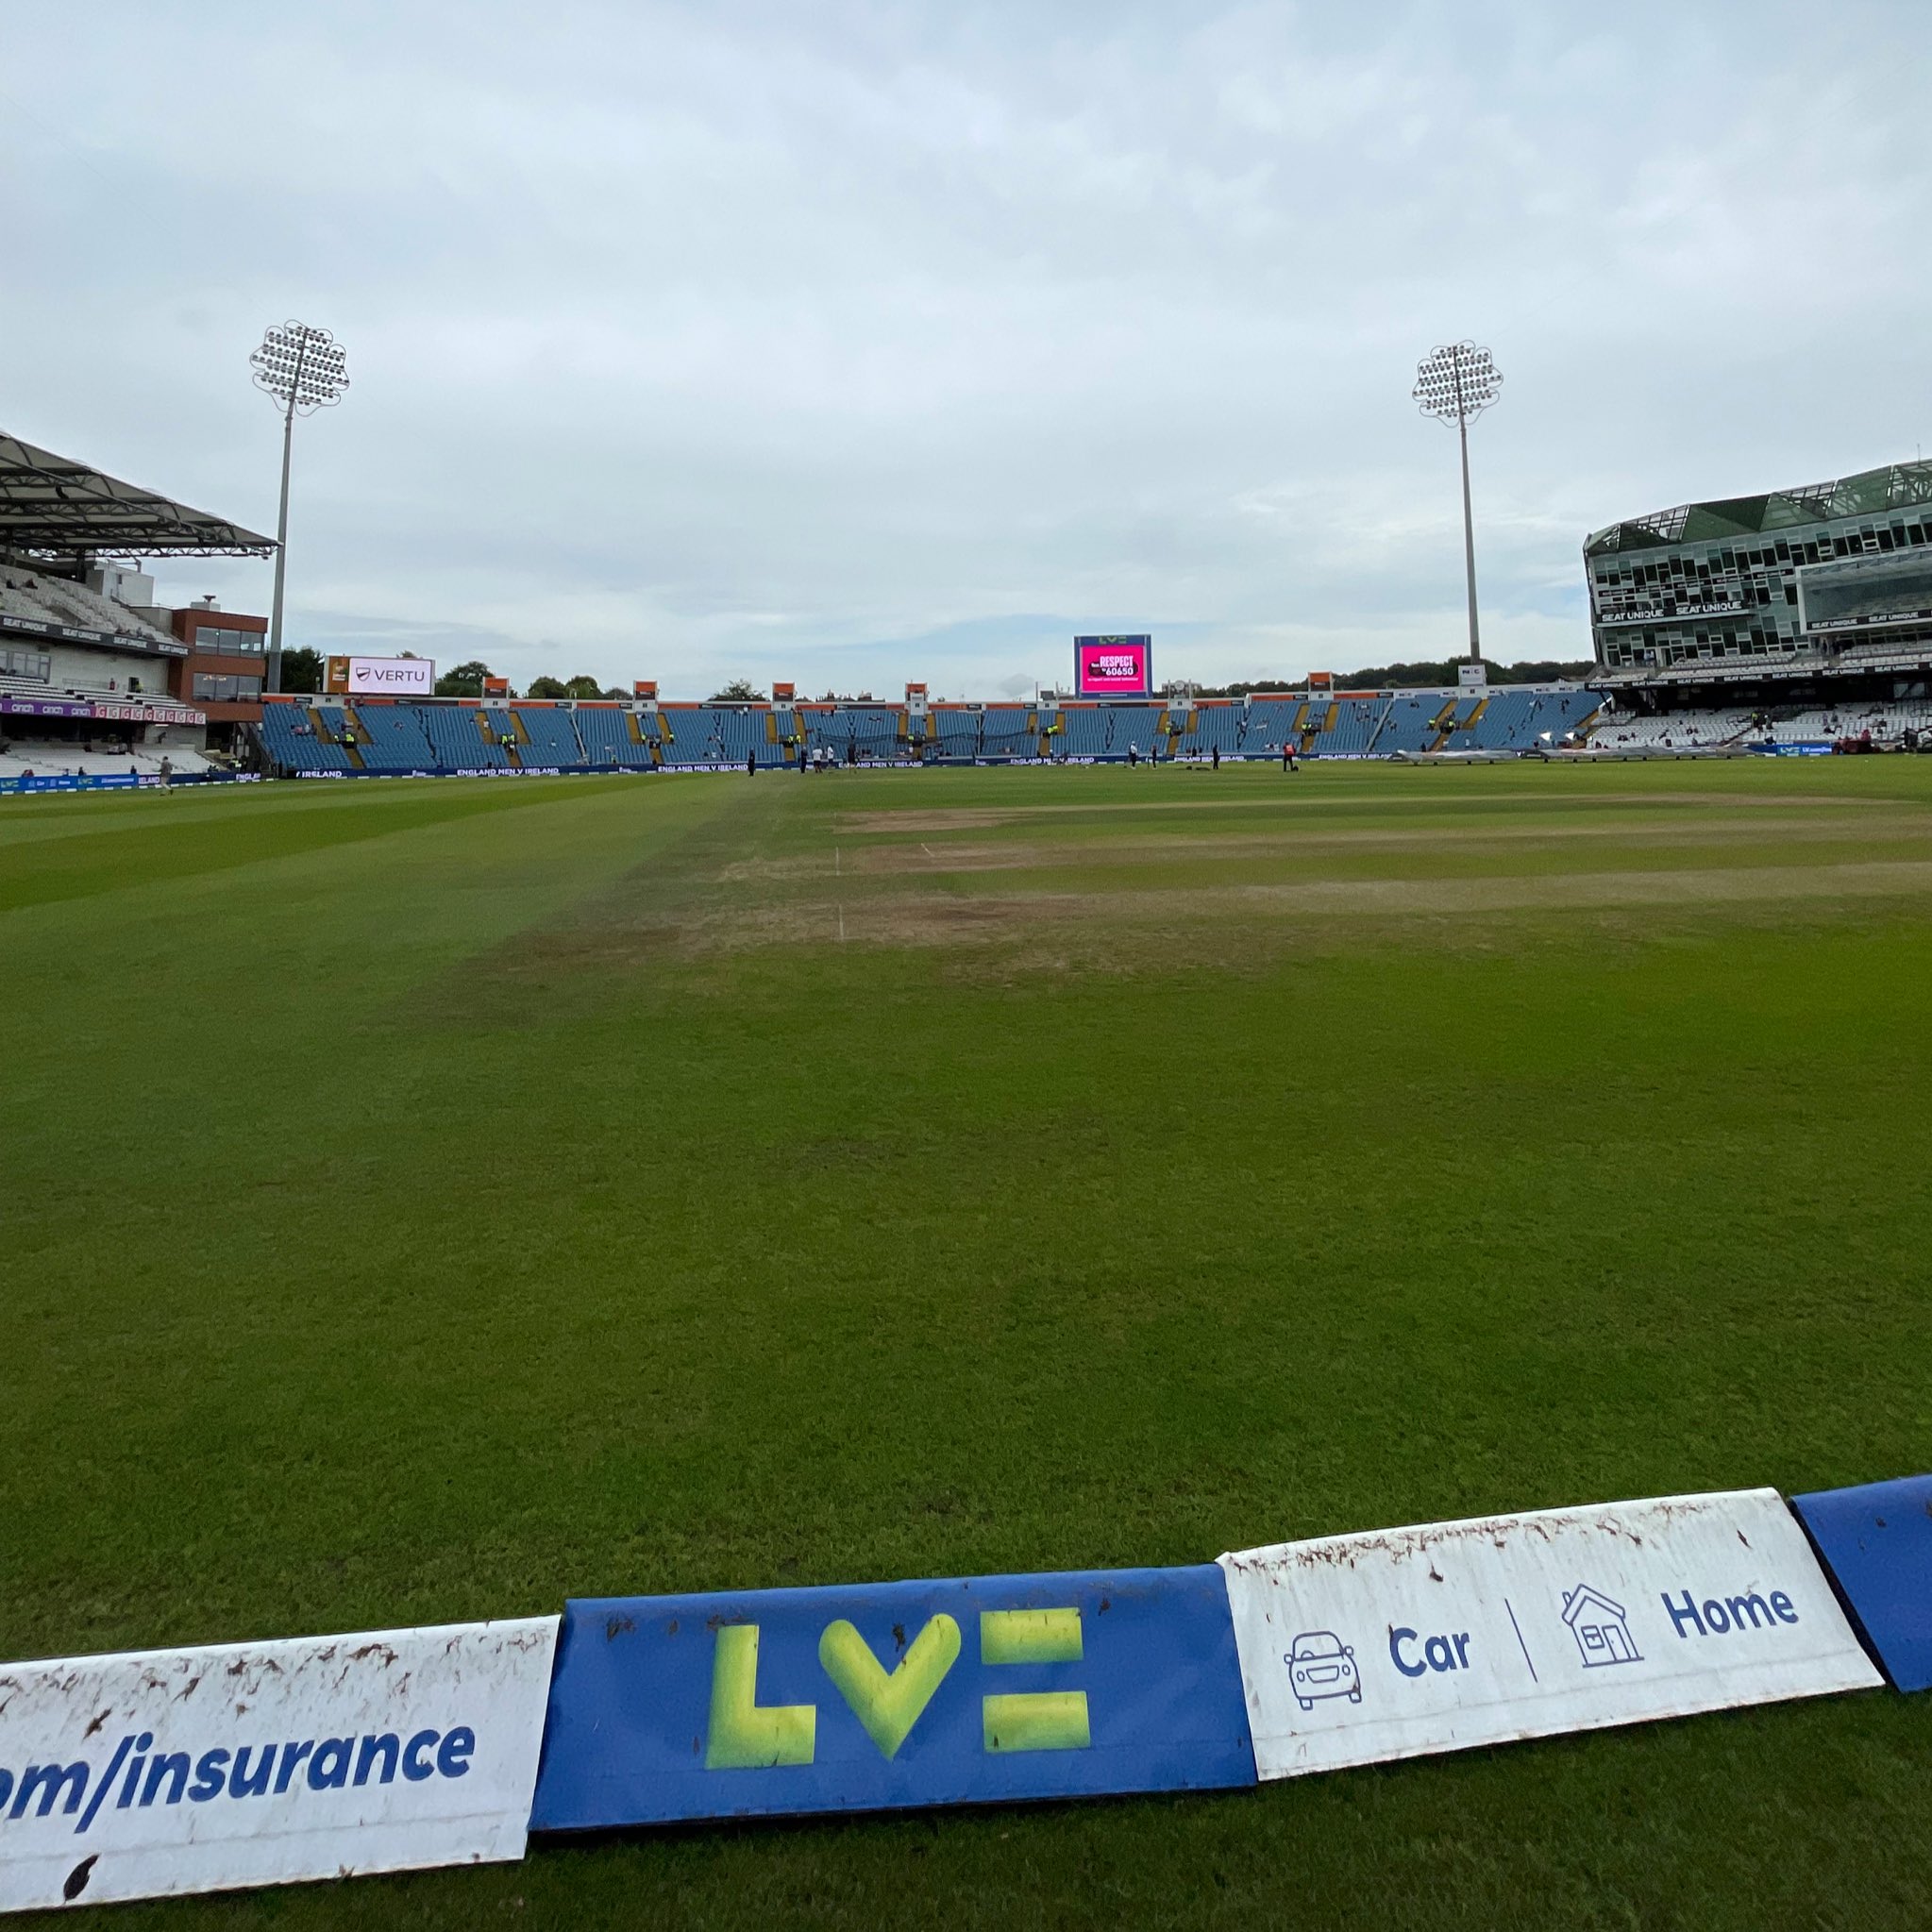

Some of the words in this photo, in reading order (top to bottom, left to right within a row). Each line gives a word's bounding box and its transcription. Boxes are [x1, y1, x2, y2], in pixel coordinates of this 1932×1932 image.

[1676, 606, 1701, 614] SEAT
[1703, 601, 1741, 613] UNIQUE
[1602, 613, 1625, 622] SEAT
[1627, 609, 1664, 619] UNIQUE
[1100, 655, 1134, 667] RESPECT
[375, 669, 425, 681] VERTU
[1105, 667, 1134, 676] 60650
[1389, 1627, 1470, 1677] Car
[1661, 1589, 1800, 1639] Home
[0, 1726, 475, 1833] m/insurance
